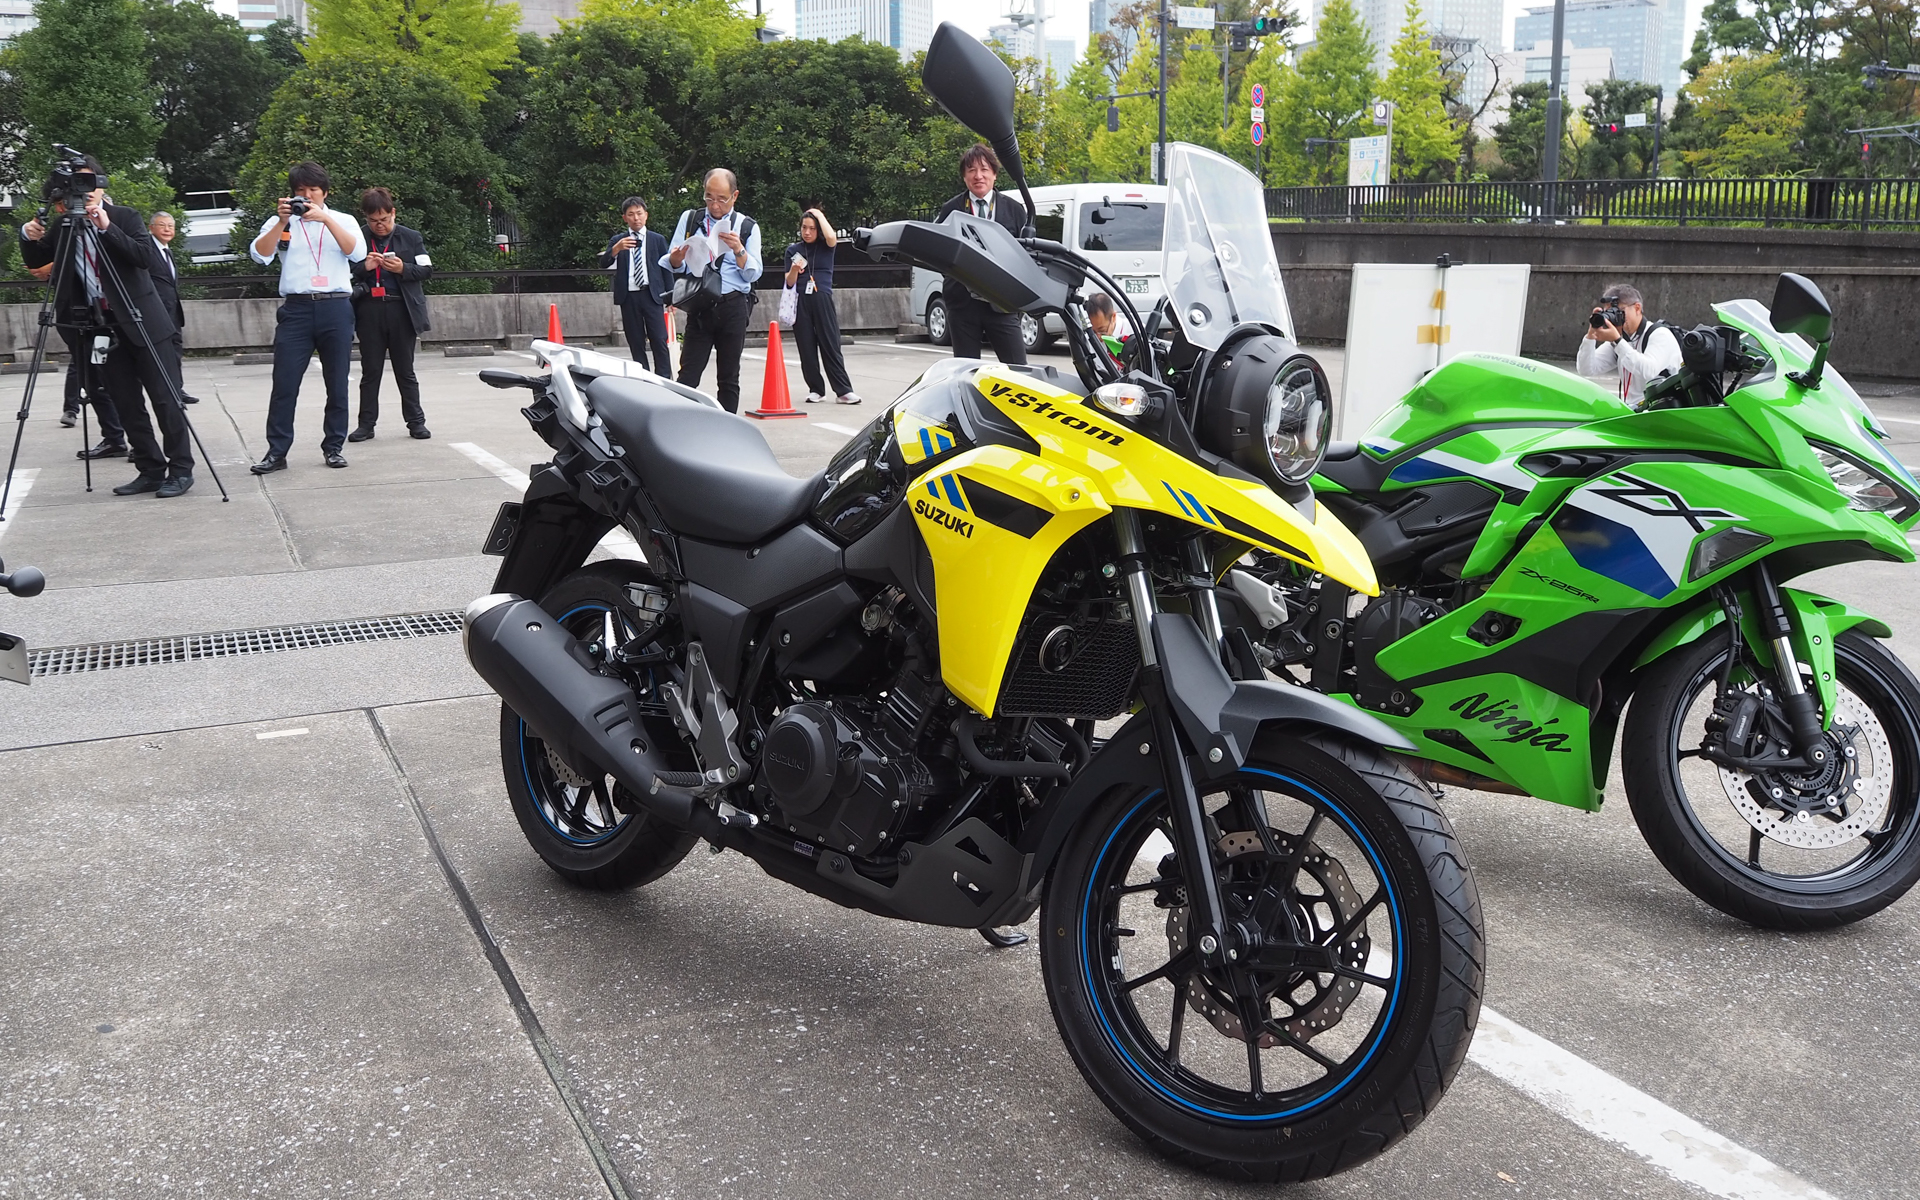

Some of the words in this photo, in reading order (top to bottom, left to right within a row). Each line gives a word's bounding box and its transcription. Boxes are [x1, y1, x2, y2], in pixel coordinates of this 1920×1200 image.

[1473, 352, 1538, 373] Kawasaki
[989, 382, 1127, 447] V-Strom
[914, 499, 975, 539] SUZUKI
[1585, 471, 1737, 534] ZX
[1448, 692, 1572, 753] Ninja
[769, 752, 806, 772] SUZUKI
